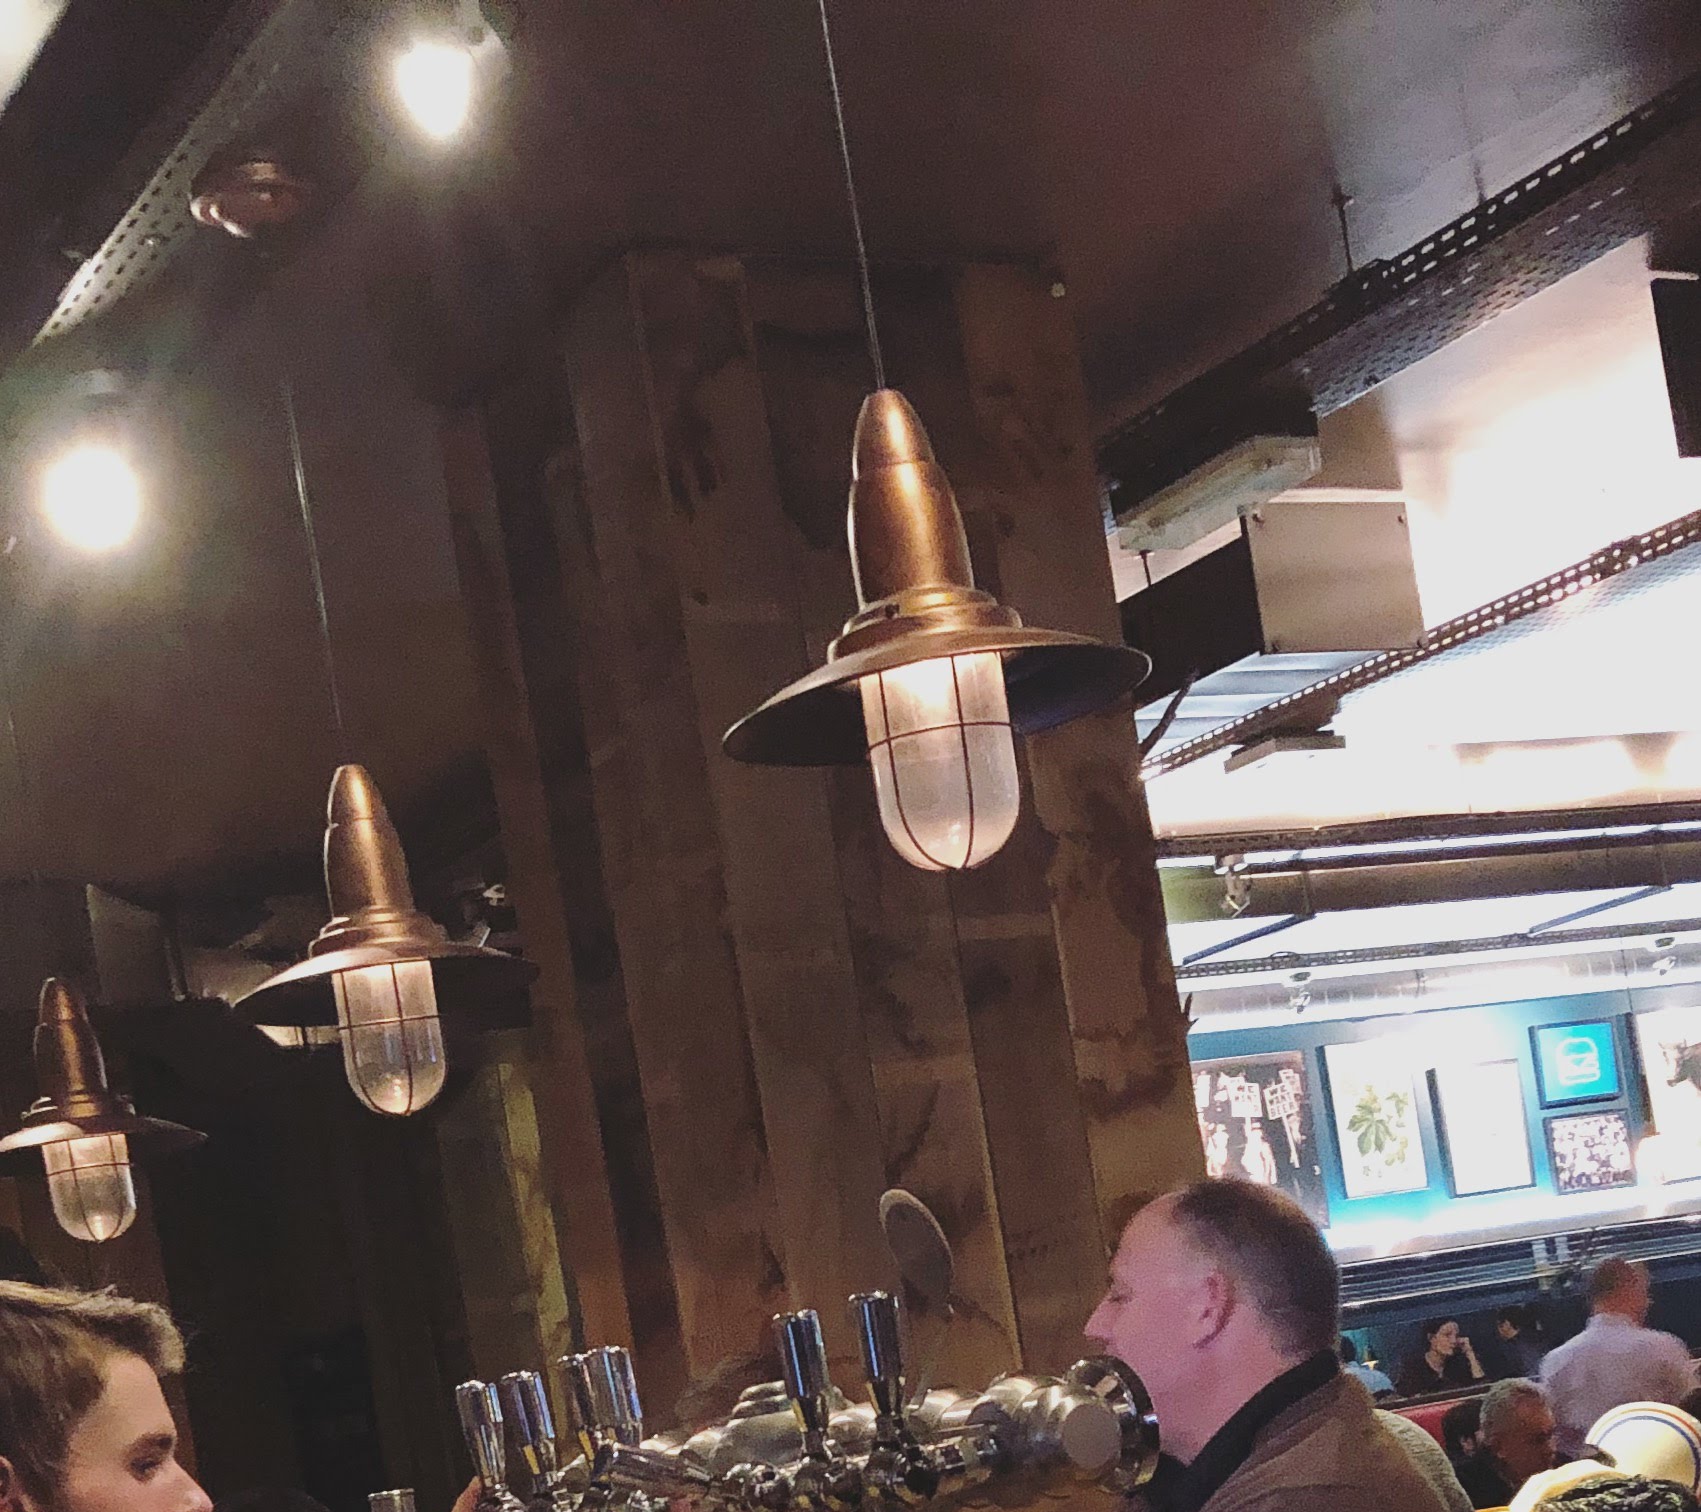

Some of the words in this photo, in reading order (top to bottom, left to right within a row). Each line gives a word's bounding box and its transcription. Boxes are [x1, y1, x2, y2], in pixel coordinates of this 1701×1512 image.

[1268, 1085, 1287, 1097] WE
[1268, 1092, 1291, 1106] WANT
[1270, 1102, 1295, 1117] BEER
